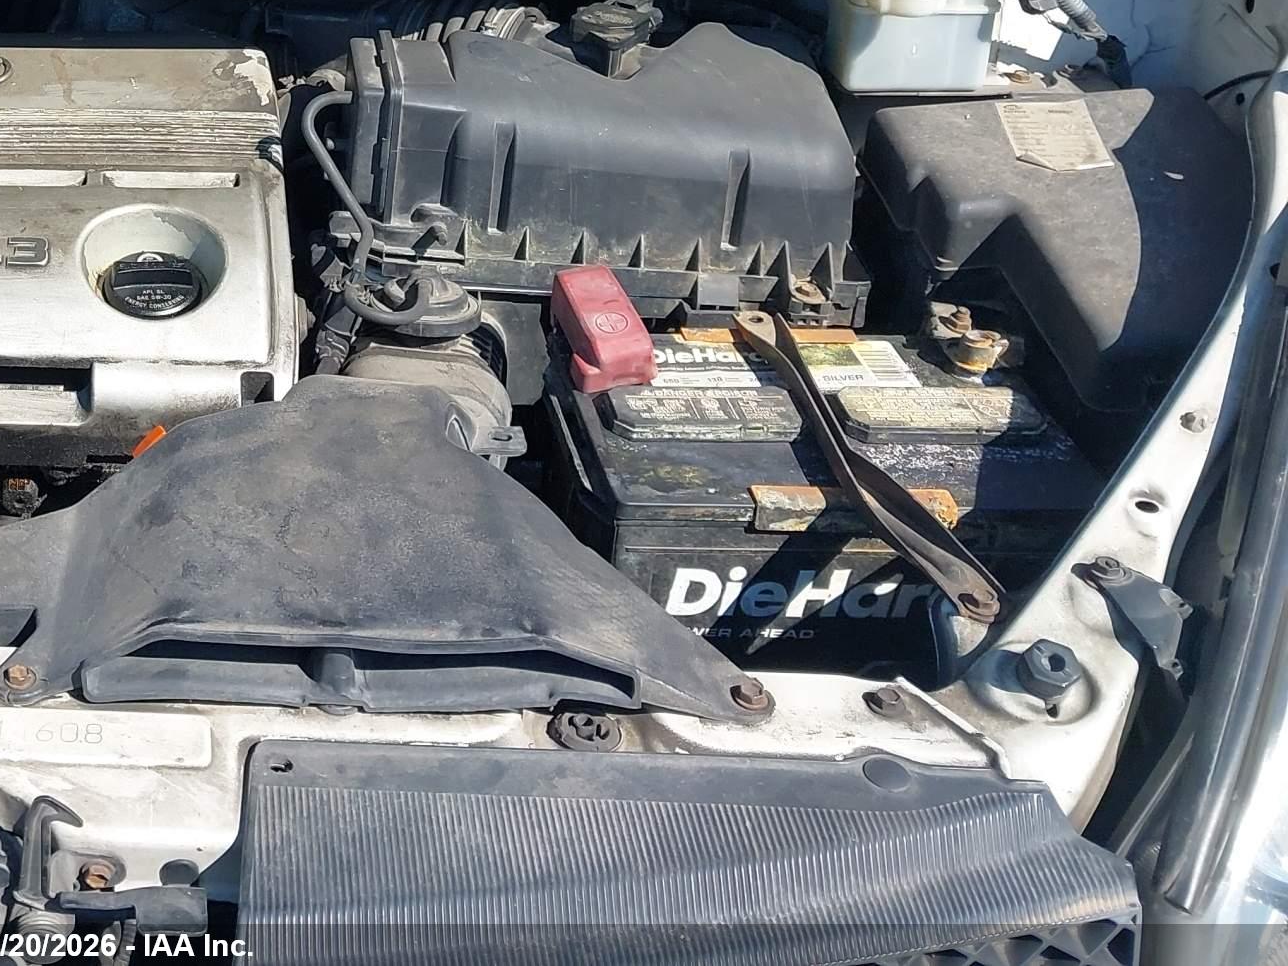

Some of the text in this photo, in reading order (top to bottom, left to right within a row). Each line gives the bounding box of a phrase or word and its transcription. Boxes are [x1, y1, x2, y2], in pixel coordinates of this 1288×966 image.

[823, 374, 864, 382] SILVER
[666, 566, 936, 618] DieHar
[688, 627, 815, 639] WER AHEAD
